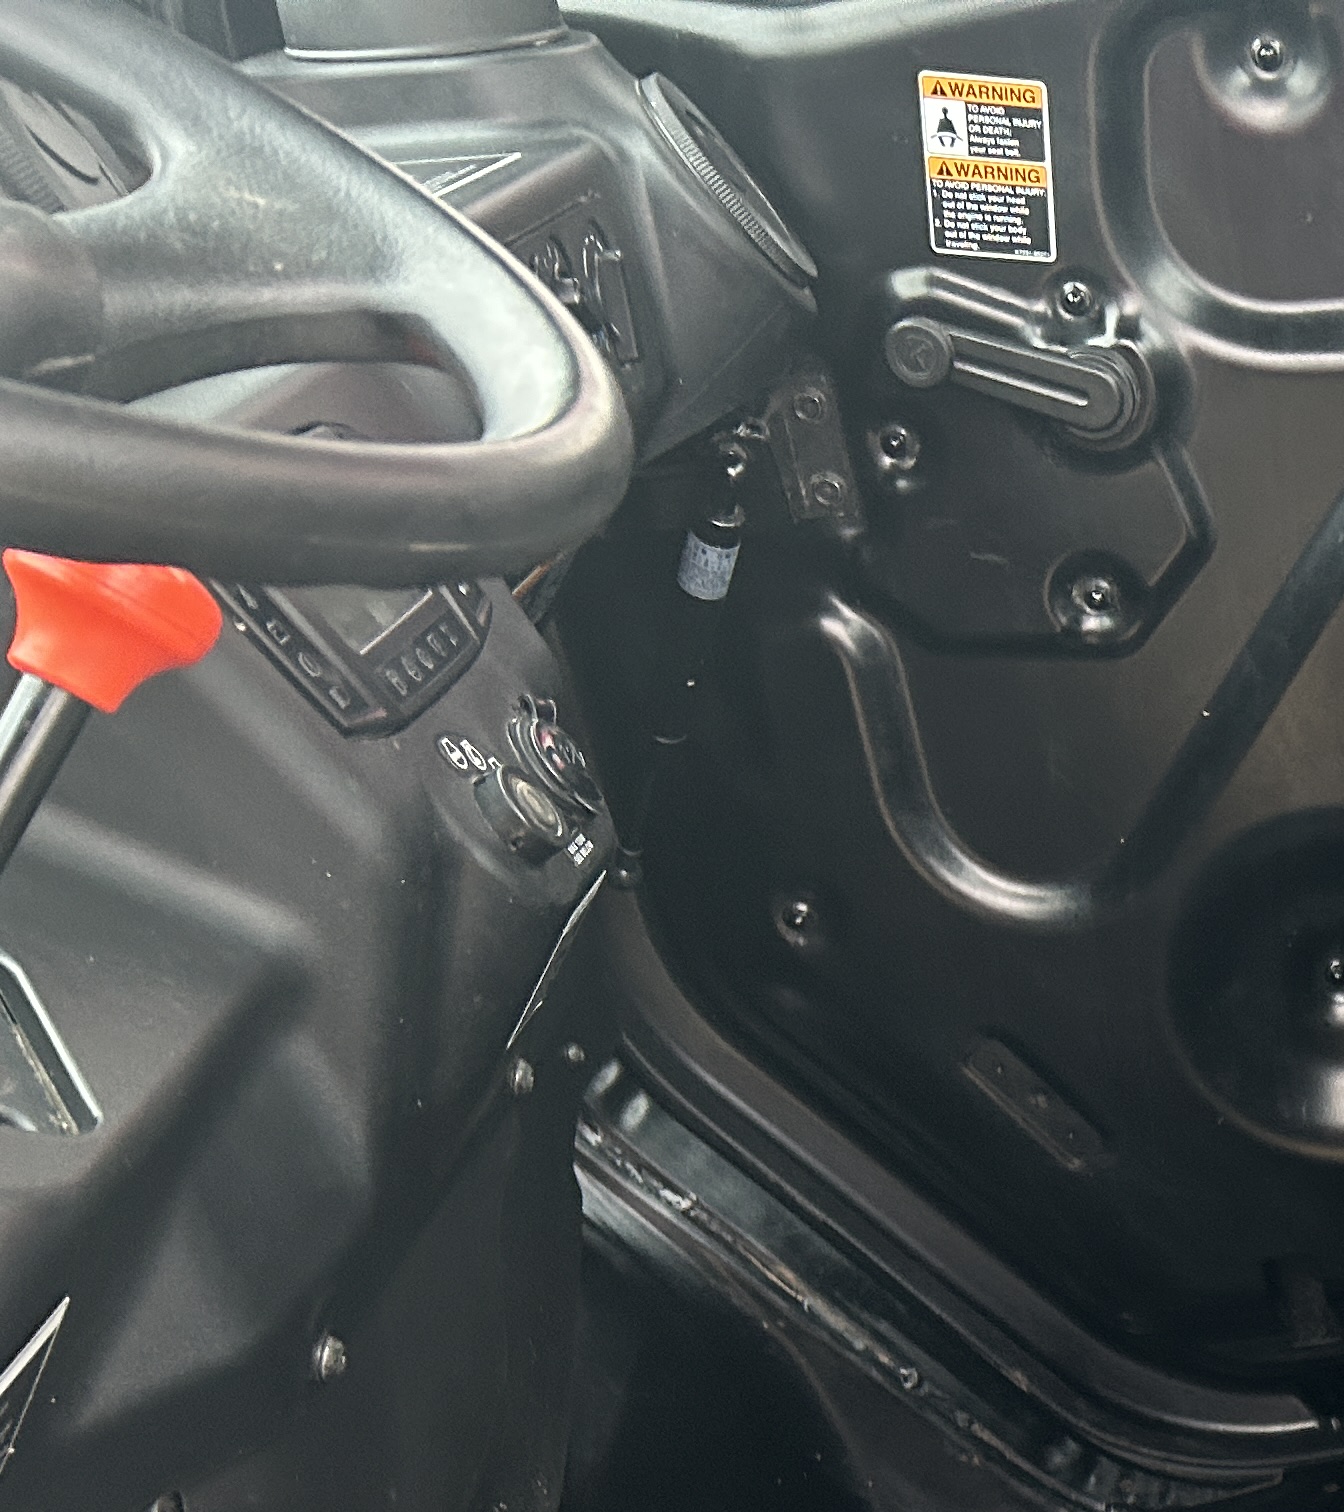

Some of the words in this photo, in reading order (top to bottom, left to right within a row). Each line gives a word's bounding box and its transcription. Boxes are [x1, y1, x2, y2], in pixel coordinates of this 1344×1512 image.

[948, 81, 1036, 104] WARNING
[967, 104, 979, 113] TO
[980, 105, 1005, 116] AVOID
[967, 114, 1011, 127] PERSONAL
[1012, 118, 1042, 129] INJURY
[968, 124, 981, 133] OR
[954, 163, 1041, 184] WARNING
[932, 179, 943, 188] TO
[945, 180, 970, 190] AVOID
[971, 182, 1014, 194] PERSONAL
[942, 189, 953, 199] Do
[954, 191, 968, 199] not
[944, 218, 956, 228] Do
[956, 220, 970, 229] not
